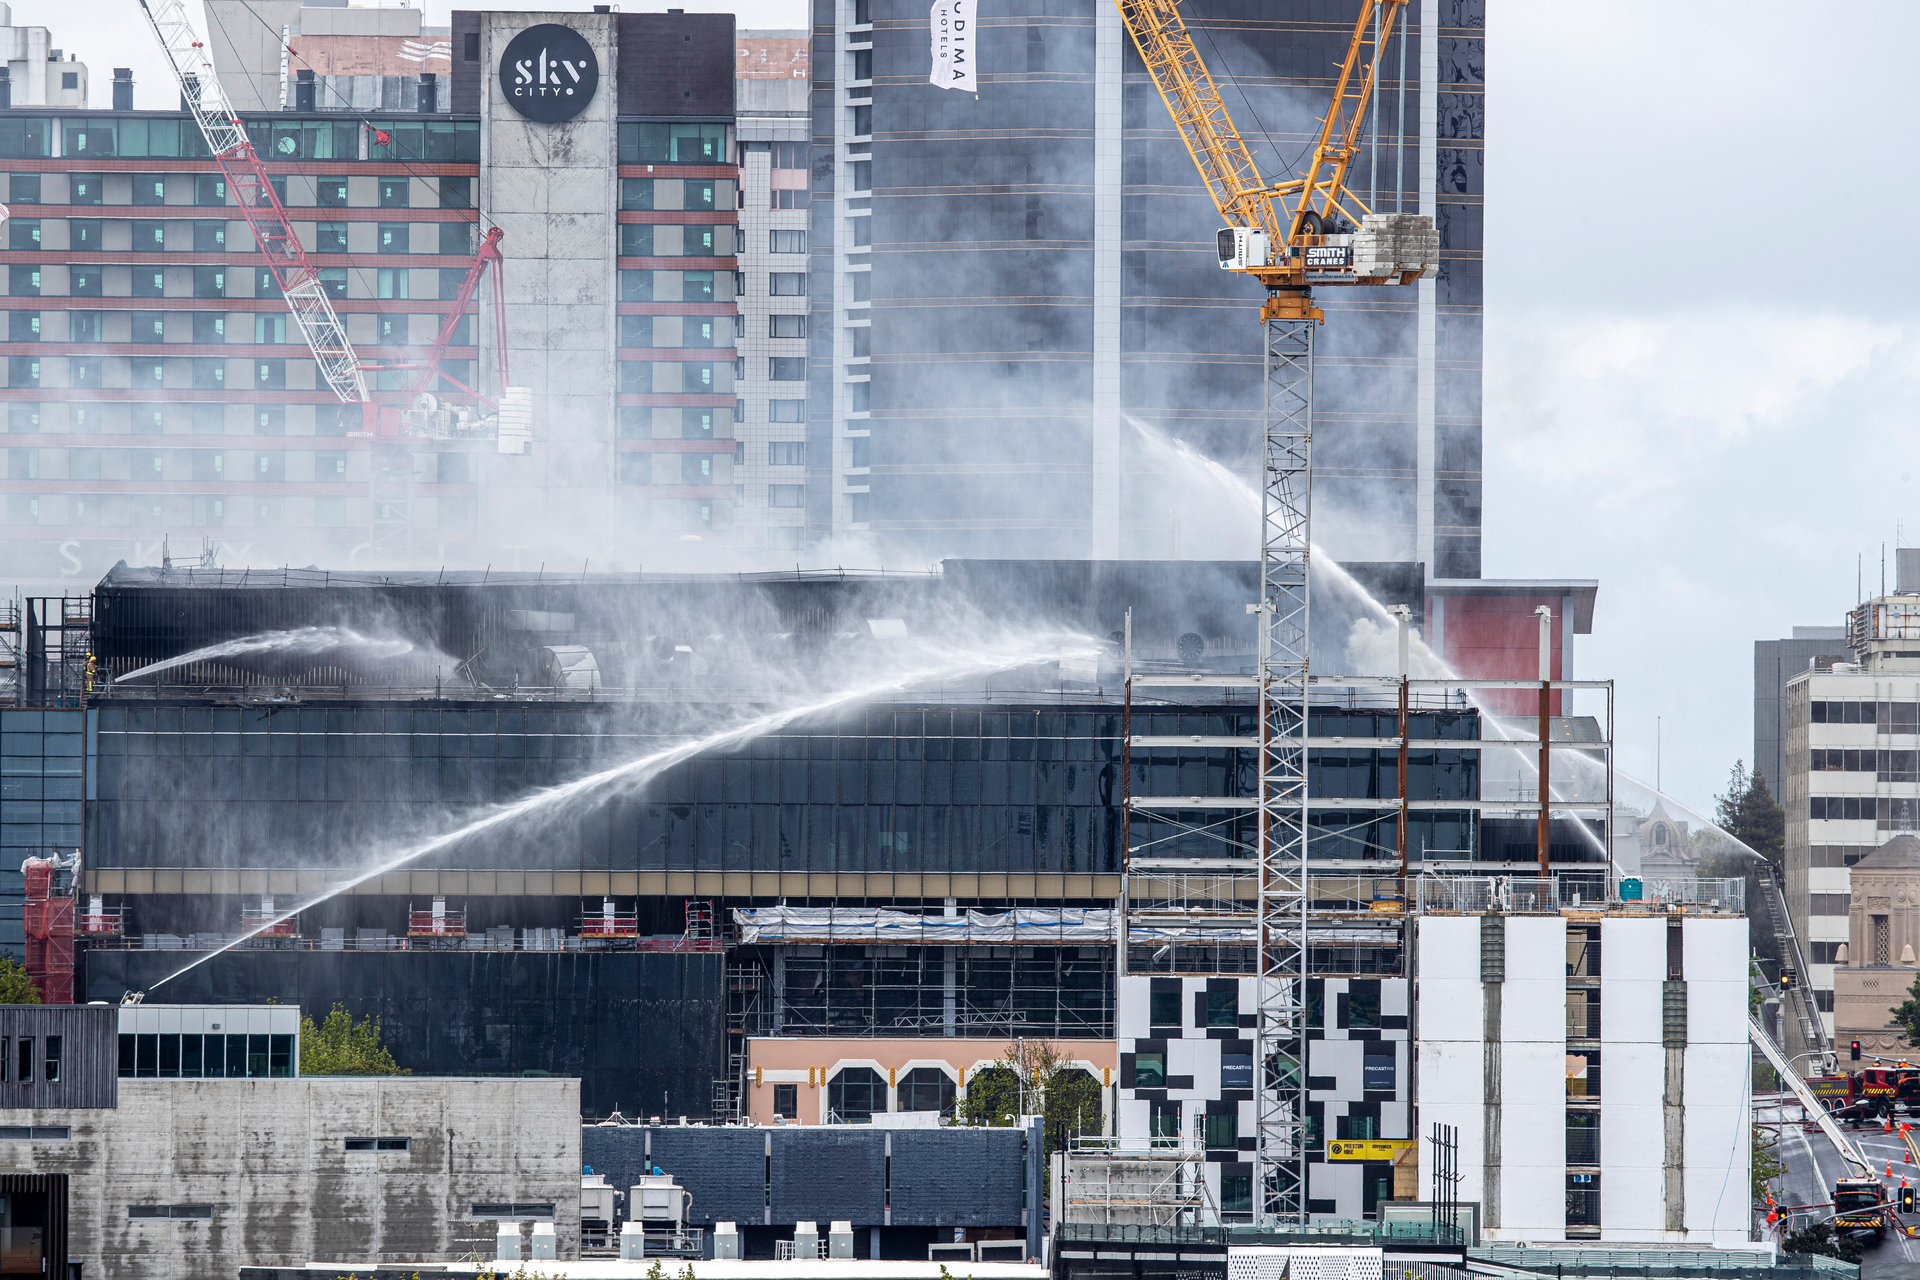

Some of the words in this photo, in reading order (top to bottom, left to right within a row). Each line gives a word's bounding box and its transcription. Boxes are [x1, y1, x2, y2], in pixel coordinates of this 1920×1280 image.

[940, 9, 948, 58] HOTELS
[514, 87, 561, 97] CITY
[1306, 247, 1346, 258] SMITH
[1306, 257, 1345, 266] CRANES
